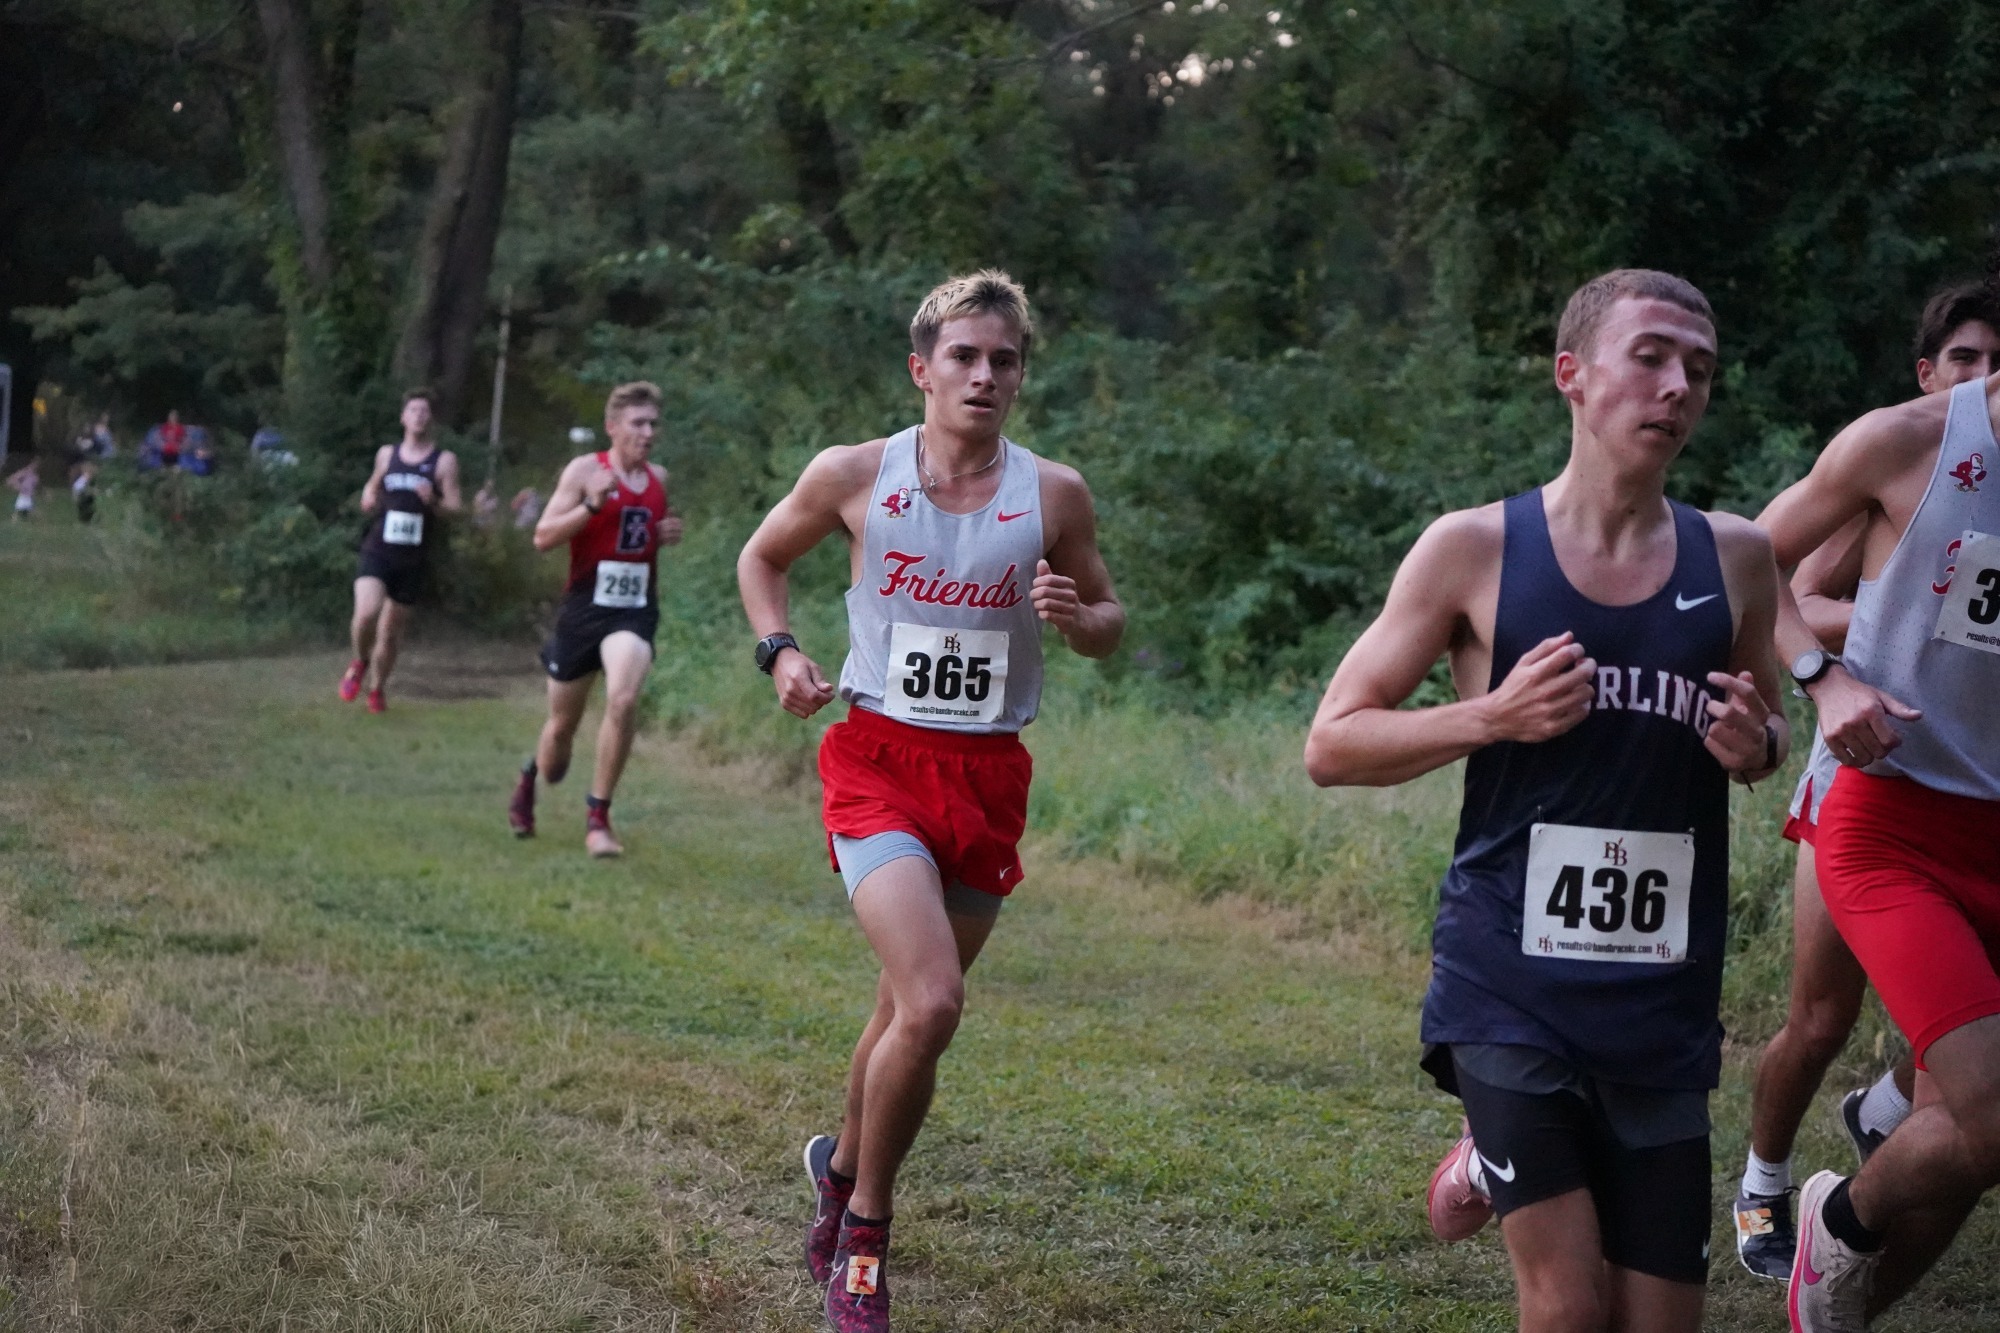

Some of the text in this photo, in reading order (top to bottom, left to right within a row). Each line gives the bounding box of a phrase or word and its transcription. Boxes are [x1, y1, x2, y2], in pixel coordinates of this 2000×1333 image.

[604, 574, 642, 596] 295
[878, 550, 1024, 609] Friends
[1968, 568, 2000, 625] 3
[902, 651, 991, 702] 365
[1596, 666, 1711, 739] RLING
[1545, 864, 1669, 933] 436
